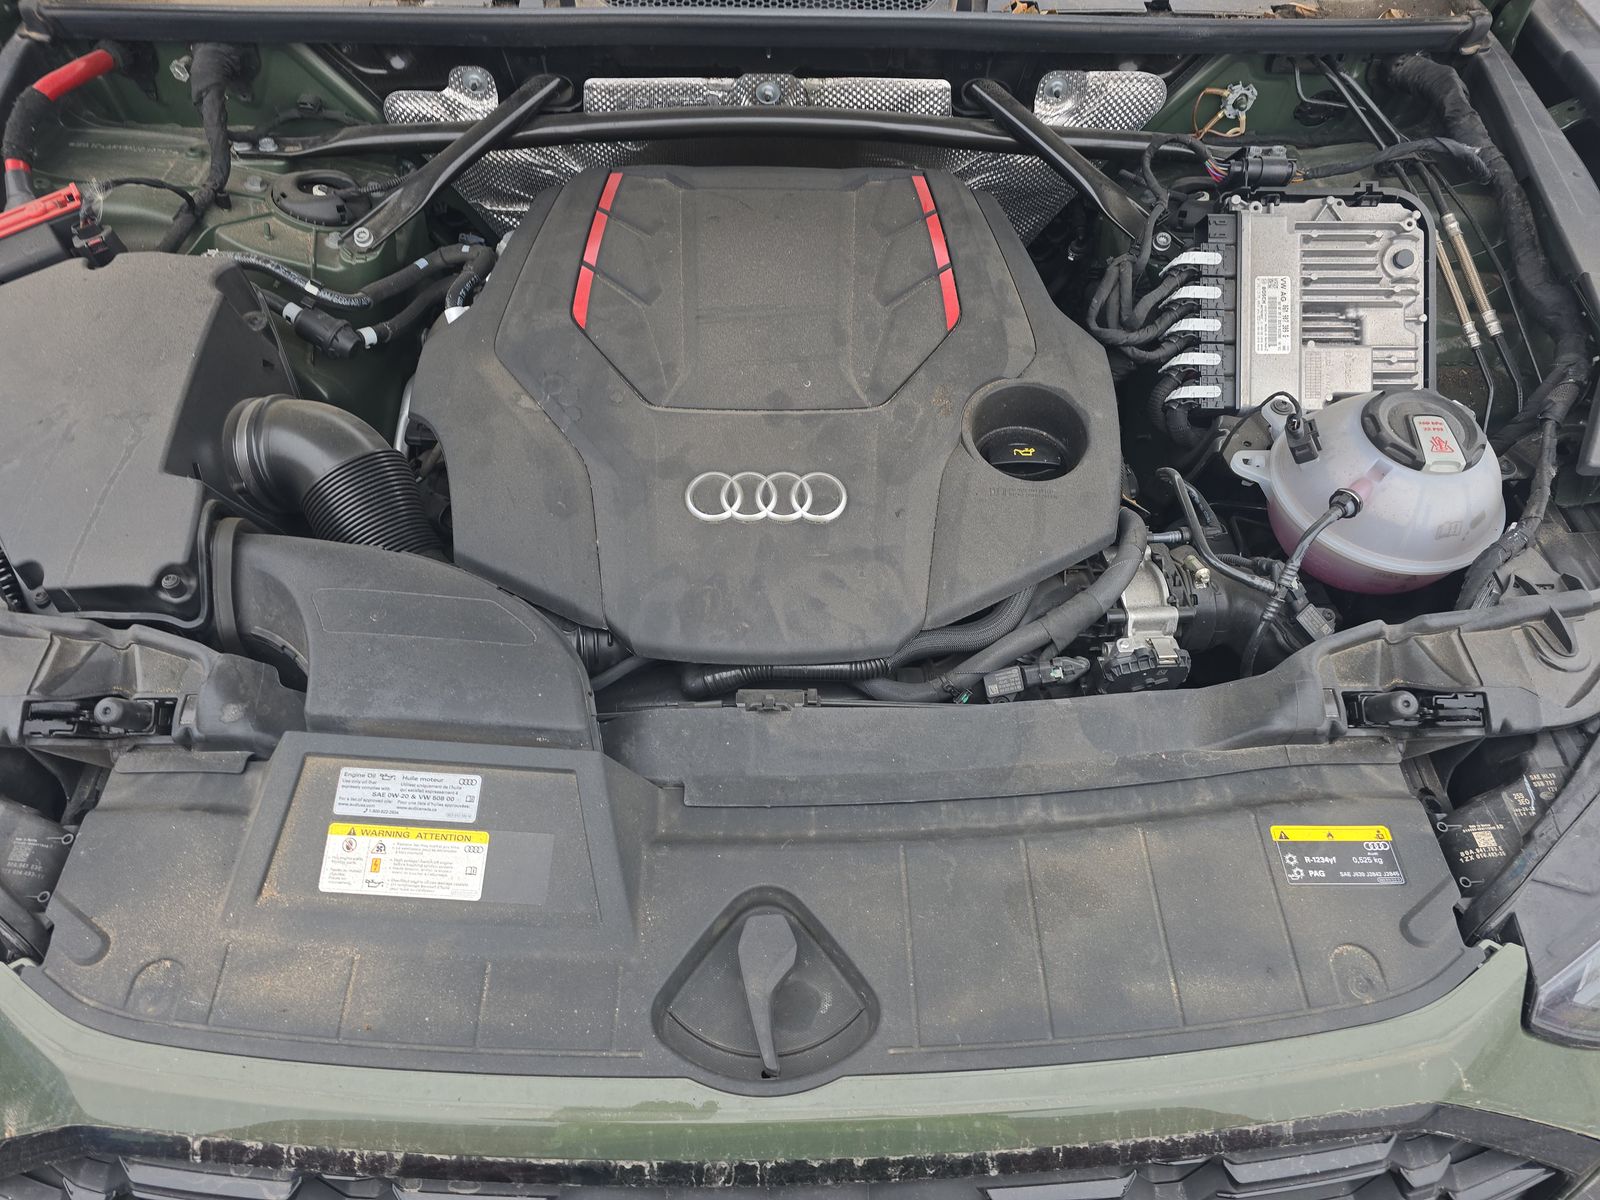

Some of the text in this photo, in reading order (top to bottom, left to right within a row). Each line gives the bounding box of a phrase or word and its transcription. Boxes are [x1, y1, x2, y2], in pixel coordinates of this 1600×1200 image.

[1280, 277, 1287, 302] VW AG
[343, 771, 366, 779] Engine
[360, 828, 472, 842] WARNING ATTENTION
[1304, 856, 1337, 865] R-1234yf
[1374, 856, 1384, 865] kg
[1307, 870, 1326, 878] PAG
